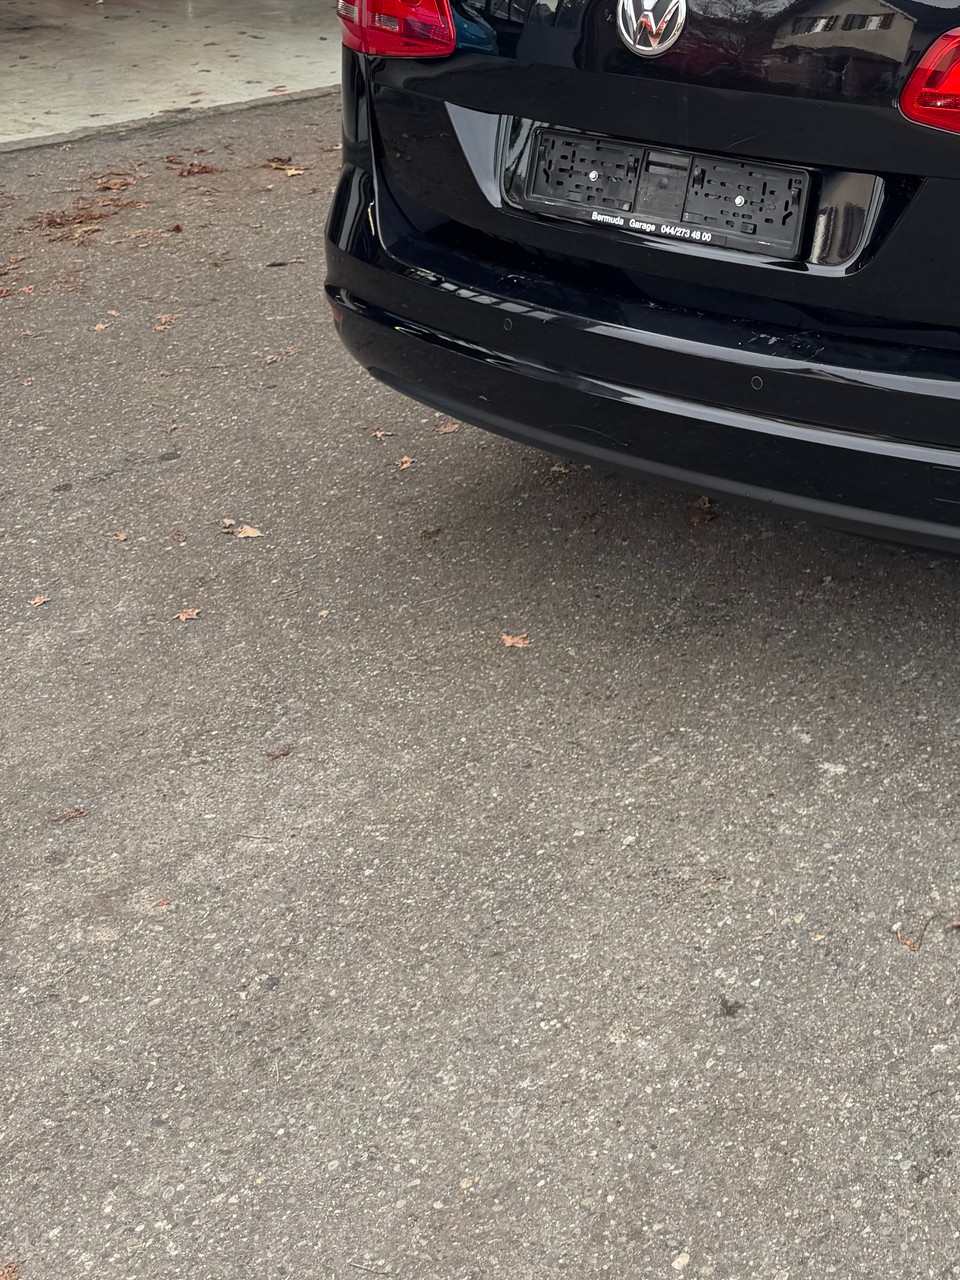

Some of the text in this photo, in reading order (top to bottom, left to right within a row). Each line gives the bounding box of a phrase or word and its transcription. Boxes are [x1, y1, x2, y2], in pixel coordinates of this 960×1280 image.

[591, 211, 712, 242] Bermuda Garage 044/273 48 00
